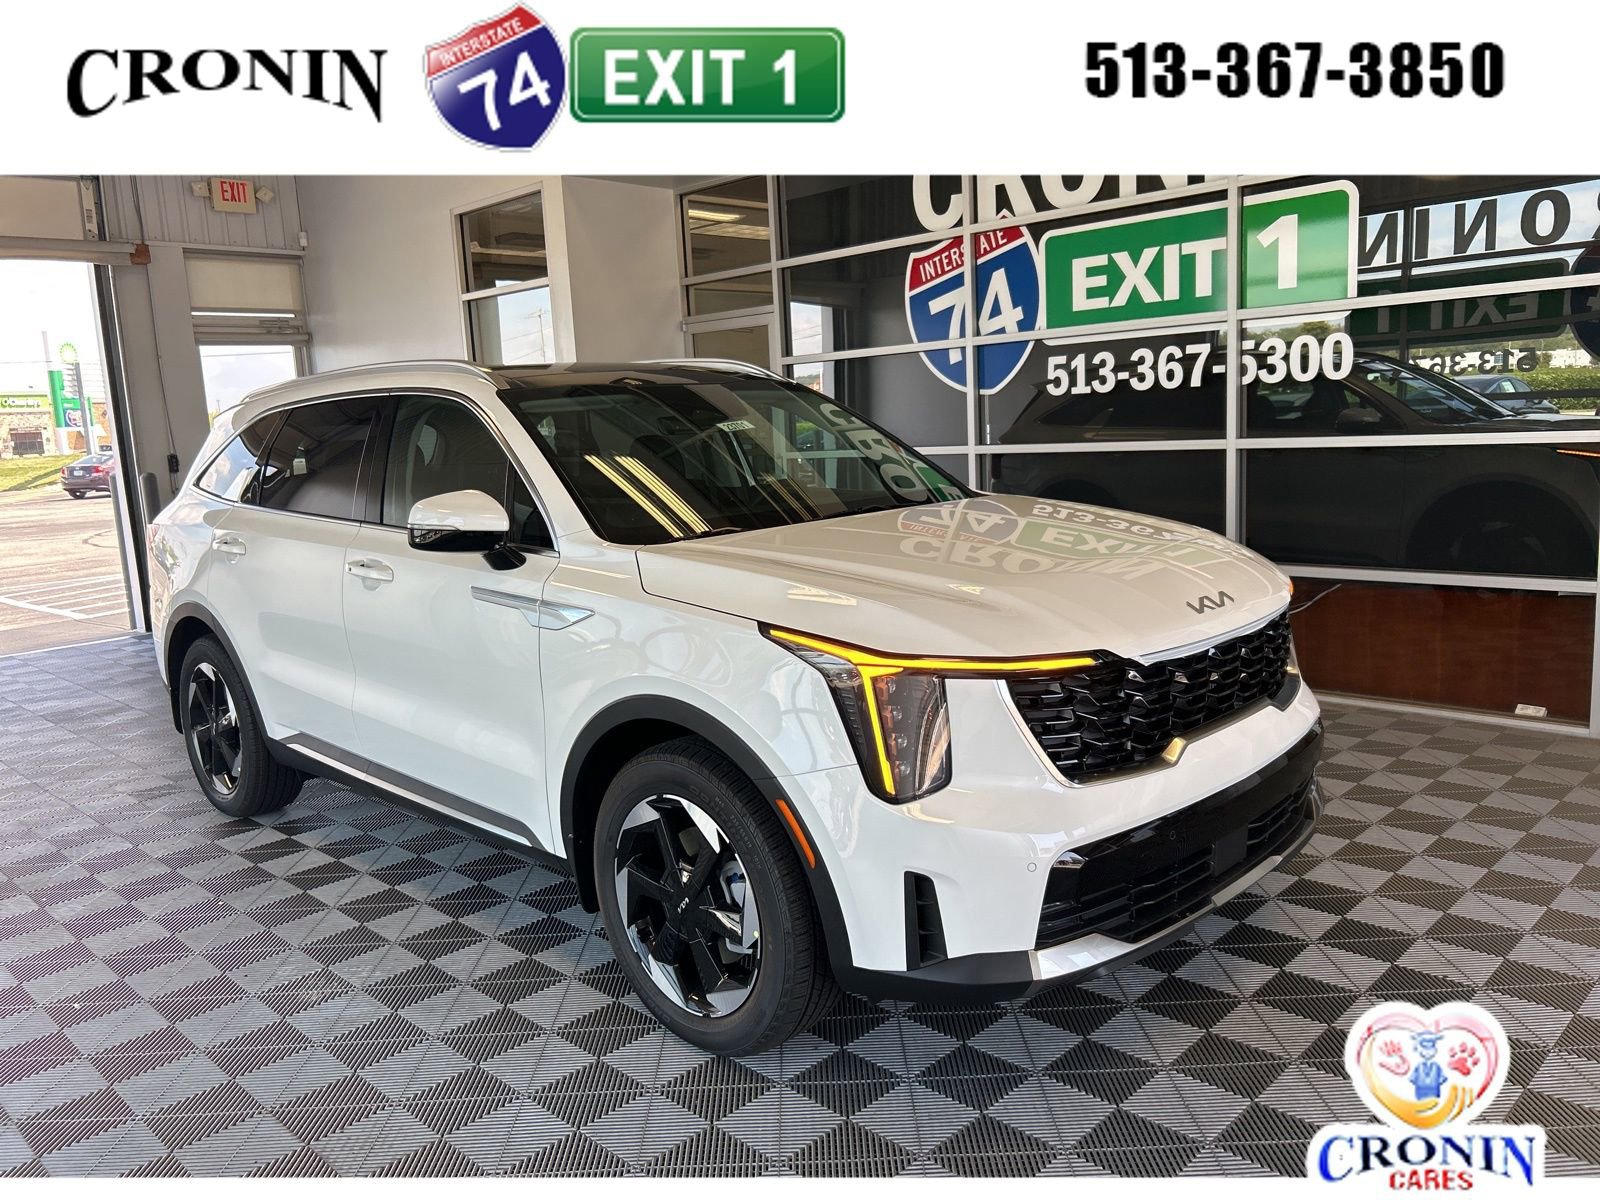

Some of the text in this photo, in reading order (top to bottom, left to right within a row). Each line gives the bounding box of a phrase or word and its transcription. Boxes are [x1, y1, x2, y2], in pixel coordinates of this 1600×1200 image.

[220, 180, 247, 203] EXIT
[919, 230, 1007, 283] INTERATE
[1072, 213, 1298, 312] EXIT 1
[928, 267, 1024, 365] 74
[1045, 332, 1354, 397] 513-367-5300
